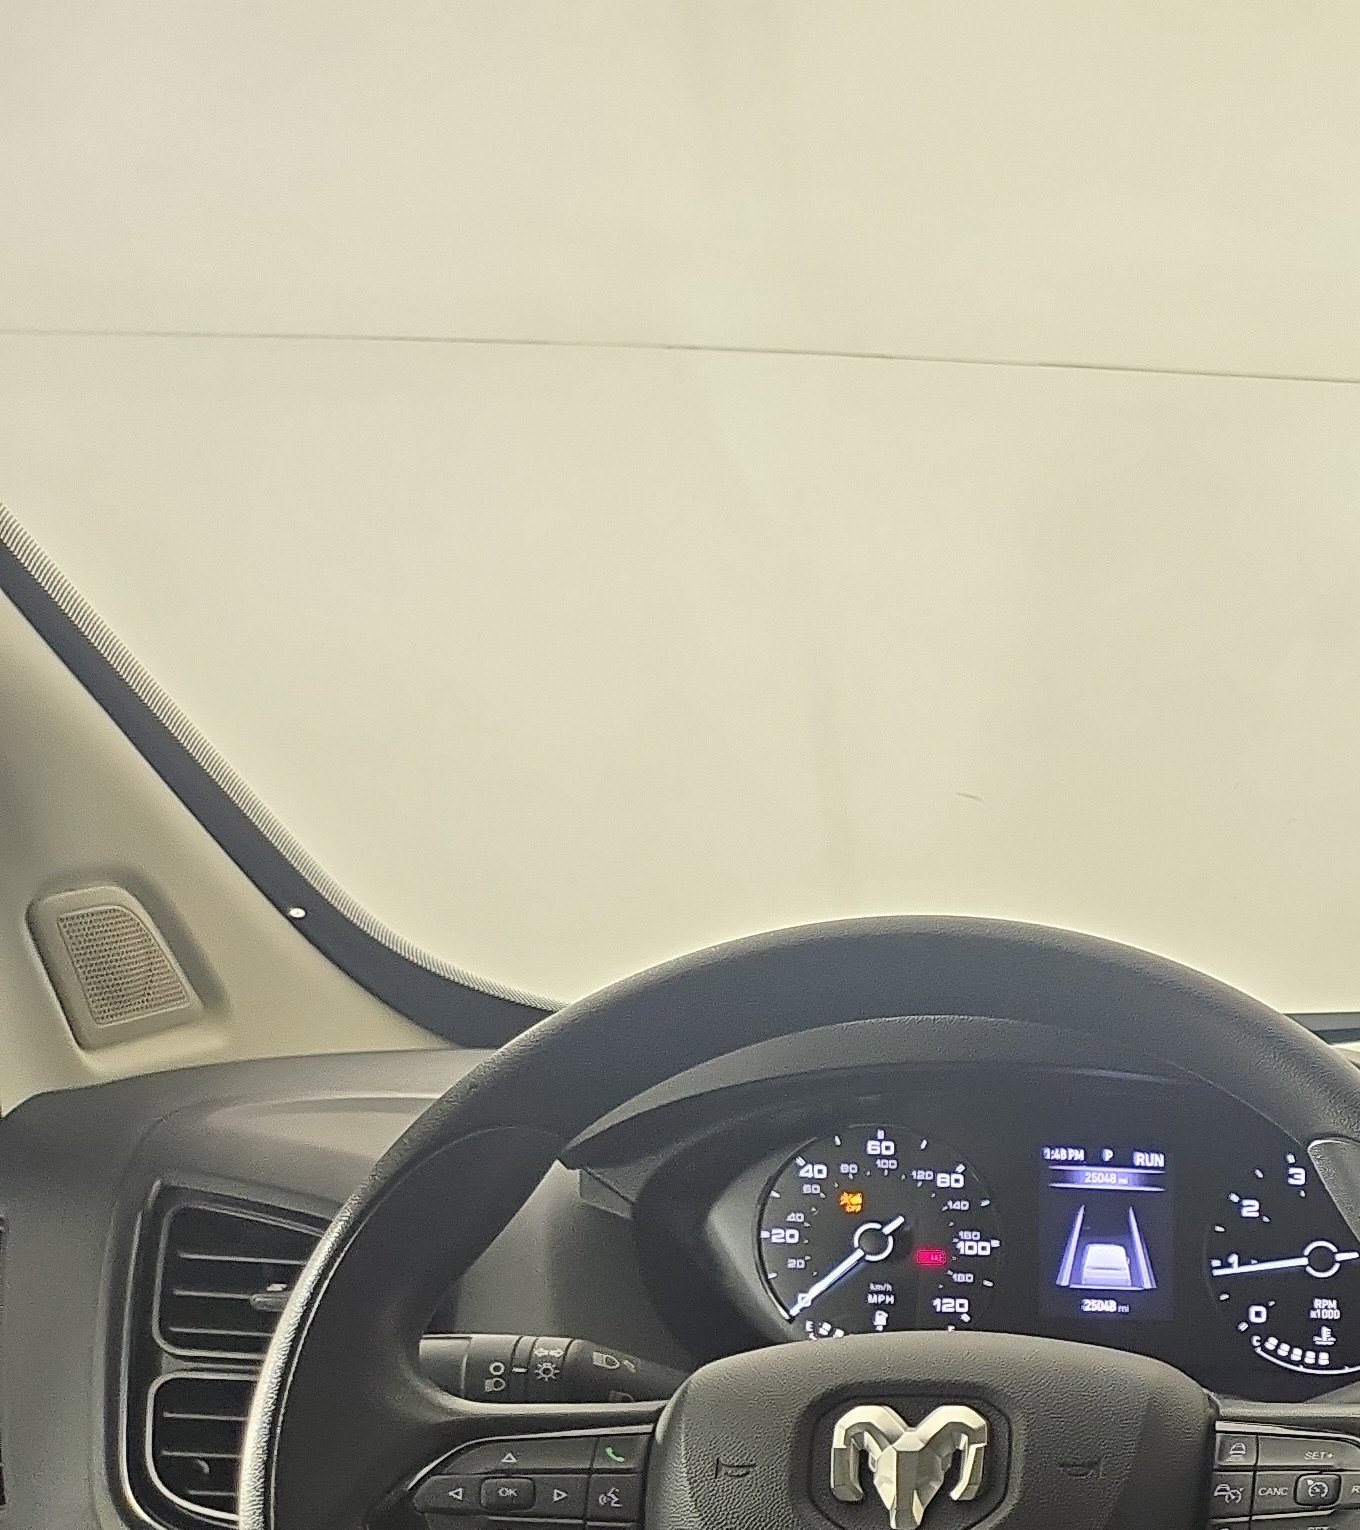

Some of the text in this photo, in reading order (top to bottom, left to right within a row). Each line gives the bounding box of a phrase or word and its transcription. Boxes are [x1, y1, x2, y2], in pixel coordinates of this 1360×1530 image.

[866, 1140, 895, 1155] 60
[1068, 1148, 1084, 1161] PM
[1103, 1149, 1113, 1161] P
[1133, 1152, 1164, 1167] RUN
[876, 1159, 898, 1169] 100
[799, 1164, 828, 1178] 40
[912, 1171, 934, 1180] 120
[1287, 1167, 1306, 1185] 3
[936, 1174, 964, 1188] 80
[1085, 1173, 1117, 1184] 25048
[947, 1201, 969, 1210] 140
[1241, 1199, 1260, 1217] 2
[786, 1213, 805, 1222] 40
[770, 1229, 799, 1243] 20
[956, 1241, 991, 1255] 100
[787, 1259, 805, 1269] 20
[867, 1295, 894, 1304] MPH
[932, 1298, 969, 1312] 120
[1082, 1299, 1117, 1312] 25048
[1313, 1298, 1337, 1309] RPM
[1249, 1305, 1267, 1323] 0
[498, 1487, 518, 1497] OK
[1258, 1487, 1289, 1495] CANC
